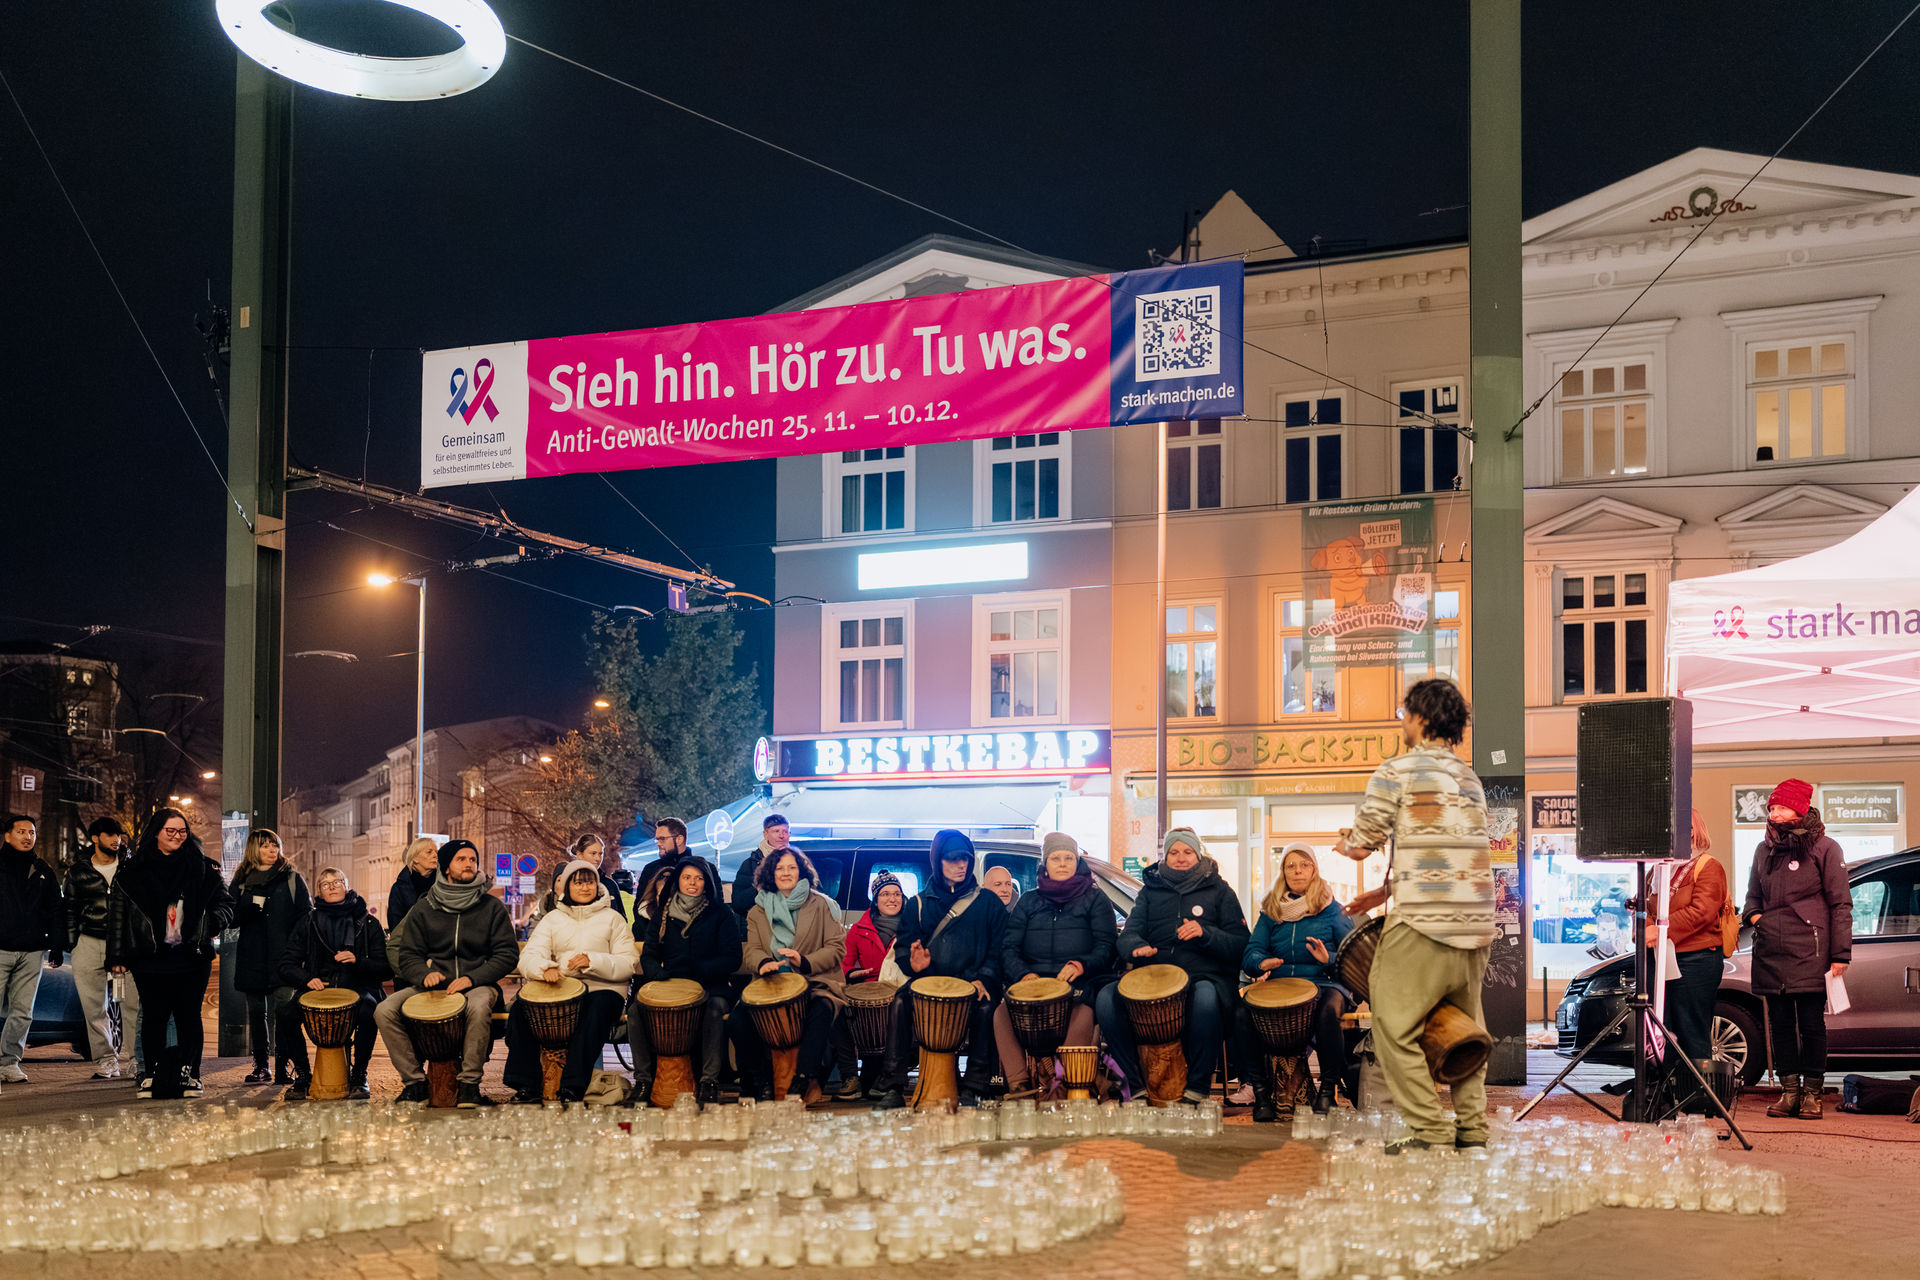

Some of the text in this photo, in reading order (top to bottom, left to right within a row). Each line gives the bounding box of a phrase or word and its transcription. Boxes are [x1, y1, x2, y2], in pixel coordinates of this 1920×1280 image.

[548, 322, 1087, 413] Sieh hin. Hör zu. Tu was.
[1120, 382, 1236, 408] stark-machen.de
[546, 413, 775, 455] Anti-Gewalt-Wochen
[782, 414, 816, 441] 25.
[823, 410, 856, 433] 11.
[887, 400, 960, 426] 10.12.
[442, 431, 505, 448] Gemeinsam
[435, 446, 512, 462] für ein gewaltfreies und
[432, 461, 514, 475] selbstbestimmtes Leben.
[1309, 500, 1421, 516] Wir Rostocker Grüne fordern:
[1362, 523, 1400, 535] BÖLLERFREI
[1367, 533, 1396, 546] JETZT!
[1332, 613, 1424, 635] und Klima!
[1352, 642, 1367, 651] von
[1368, 640, 1396, 651] Schutz-
[1397, 640, 1413, 649] und
[1309, 650, 1427, 663] Ruhezonen bei Silvesterfeuerwerk
[815, 731, 1100, 775] BESTKEBAP
[1179, 733, 1407, 766] BIO-BACKSTU
[1828, 795, 1891, 805] mit oder ohne
[1835, 806, 1882, 818] Termin
[1130, 820, 1141, 835] 13
